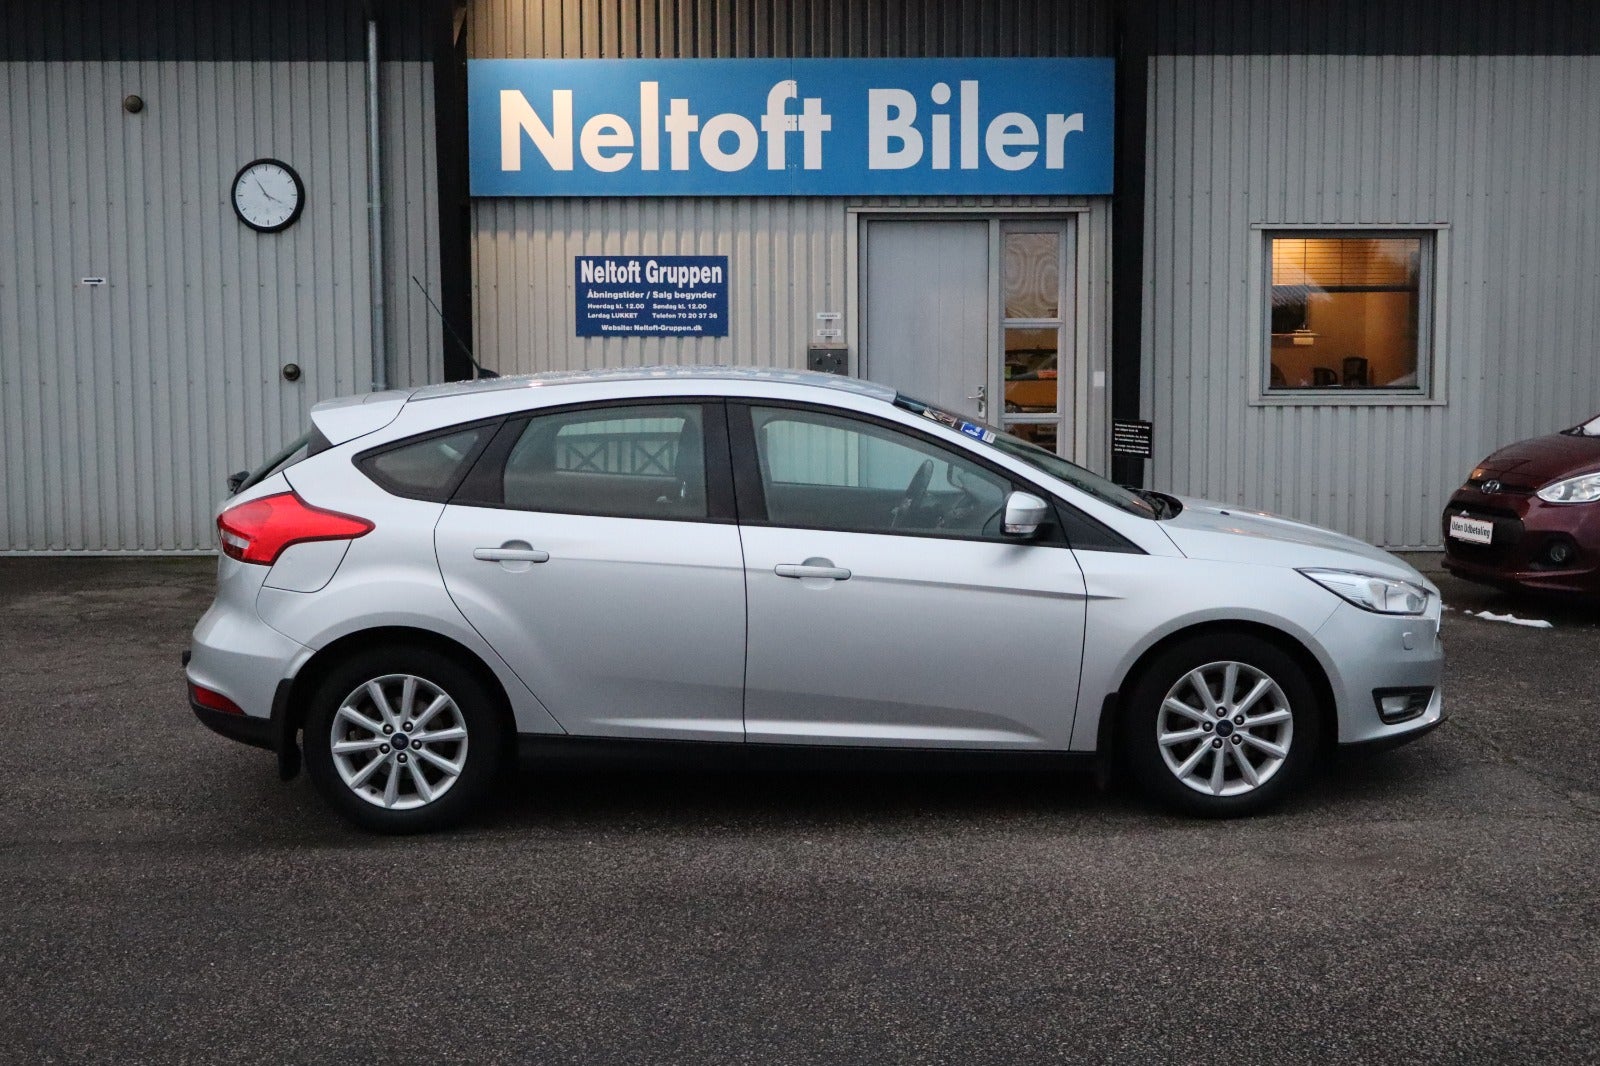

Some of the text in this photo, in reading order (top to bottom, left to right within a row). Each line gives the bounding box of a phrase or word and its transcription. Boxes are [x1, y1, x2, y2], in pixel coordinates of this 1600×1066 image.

[500, 80, 1084, 172] Neltoft Biler
[580, 259, 723, 288] Neltoft Gruppen
[587, 288, 717, 300] Åbningstider / Salg begynder
[634, 324, 703, 332] Neltoft-Gruppen.dk
[1452, 521, 1490, 539] Uden Udbetaling
